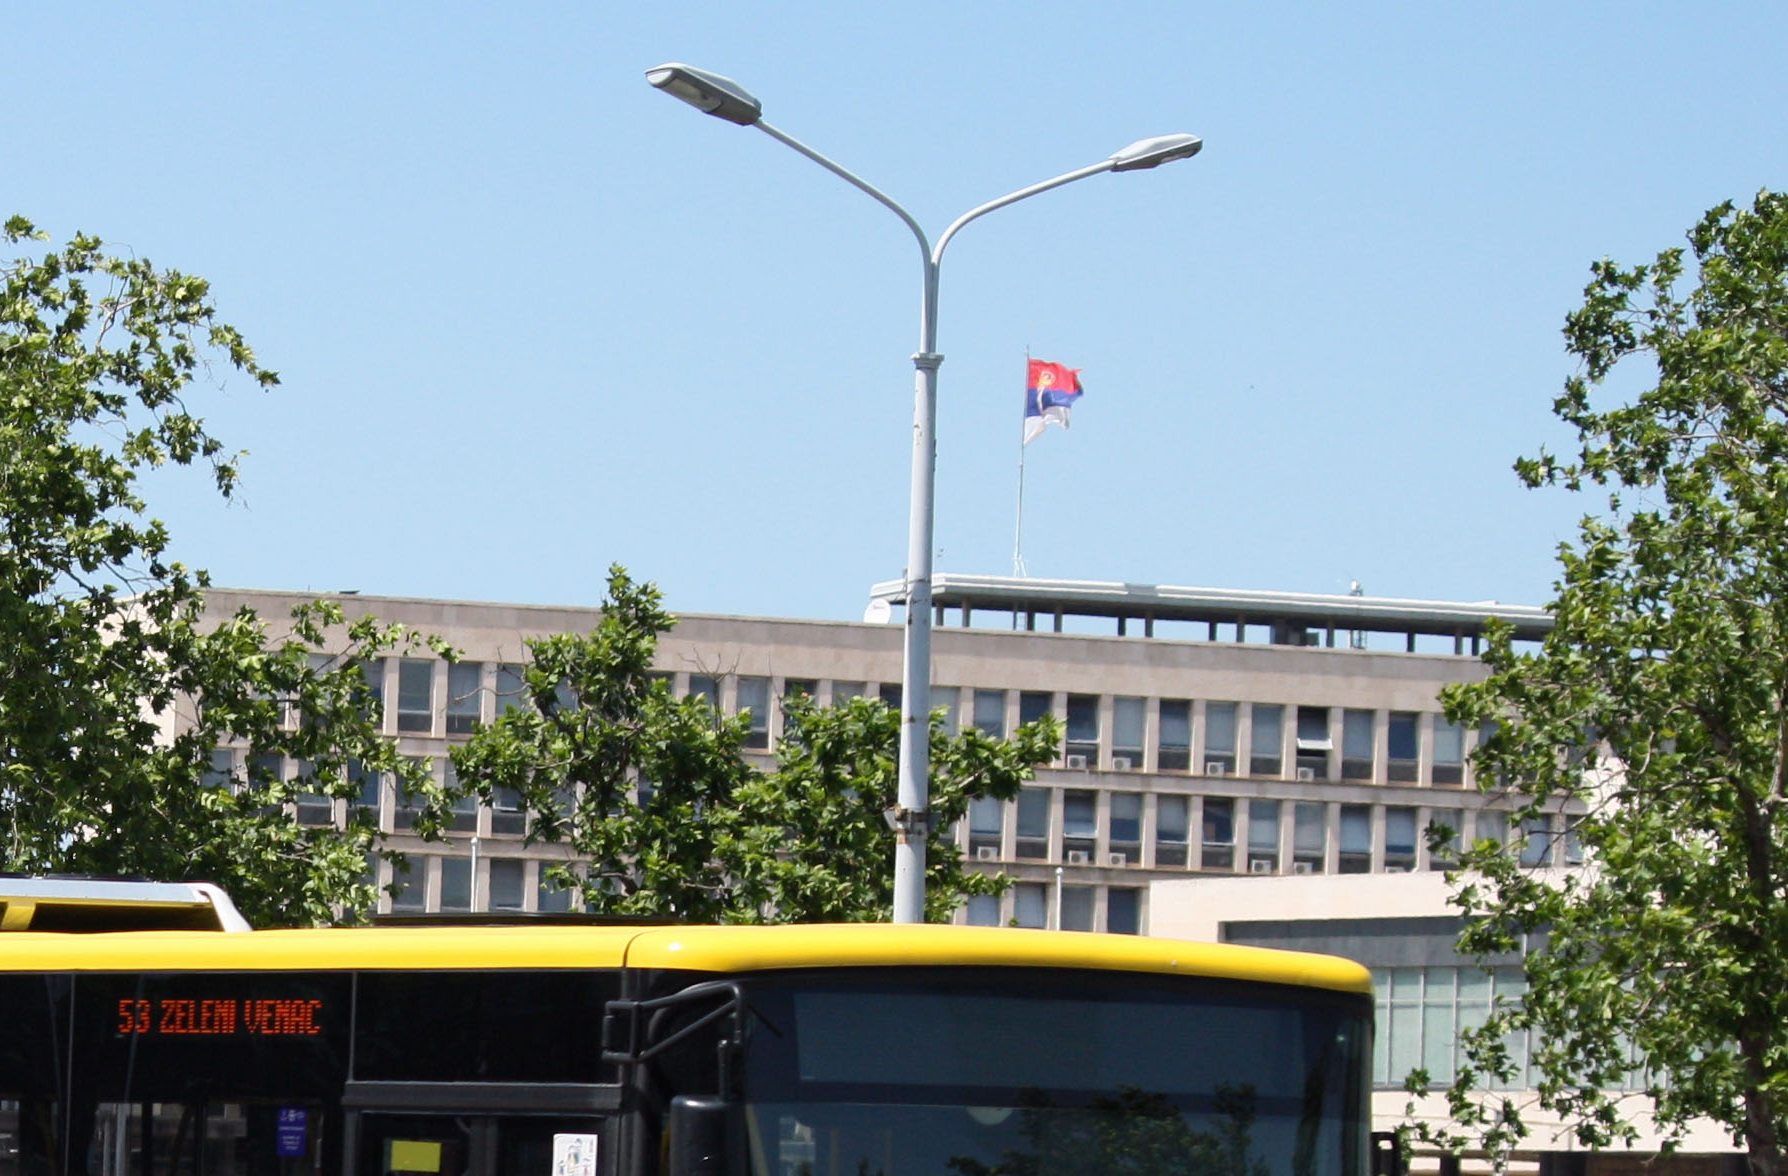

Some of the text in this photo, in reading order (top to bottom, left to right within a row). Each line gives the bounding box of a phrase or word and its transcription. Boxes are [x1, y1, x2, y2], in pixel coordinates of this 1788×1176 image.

[117, 1000, 322, 1033] 53 ZELENI VENAC
